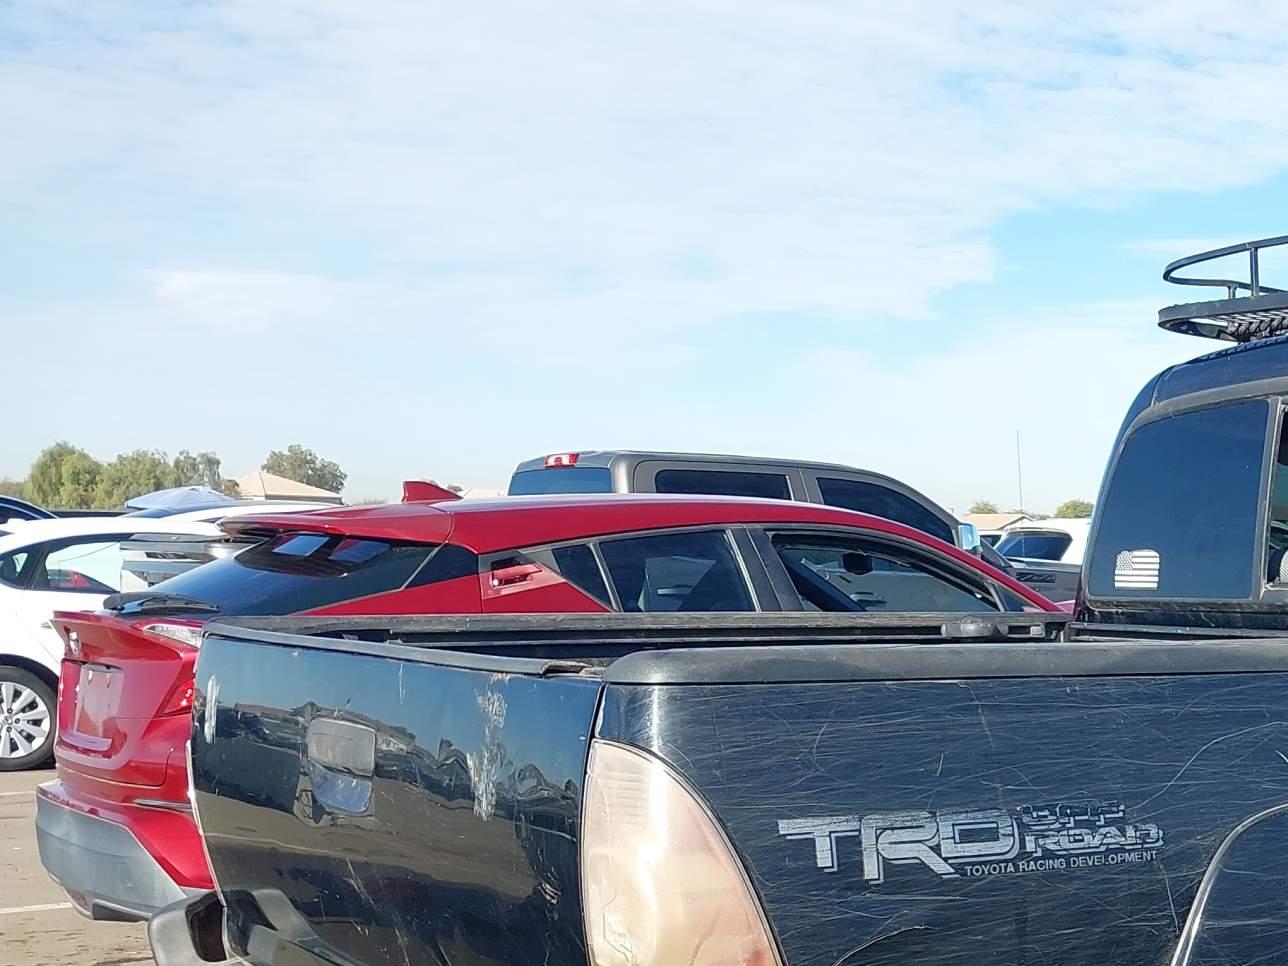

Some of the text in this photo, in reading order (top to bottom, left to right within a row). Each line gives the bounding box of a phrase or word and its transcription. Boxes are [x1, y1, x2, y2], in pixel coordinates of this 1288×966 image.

[777, 809, 1020, 885] TRD
[1024, 823, 1165, 857] ROAD
[964, 850, 1158, 877] TOYOTA RACING DEVELOPMENT
